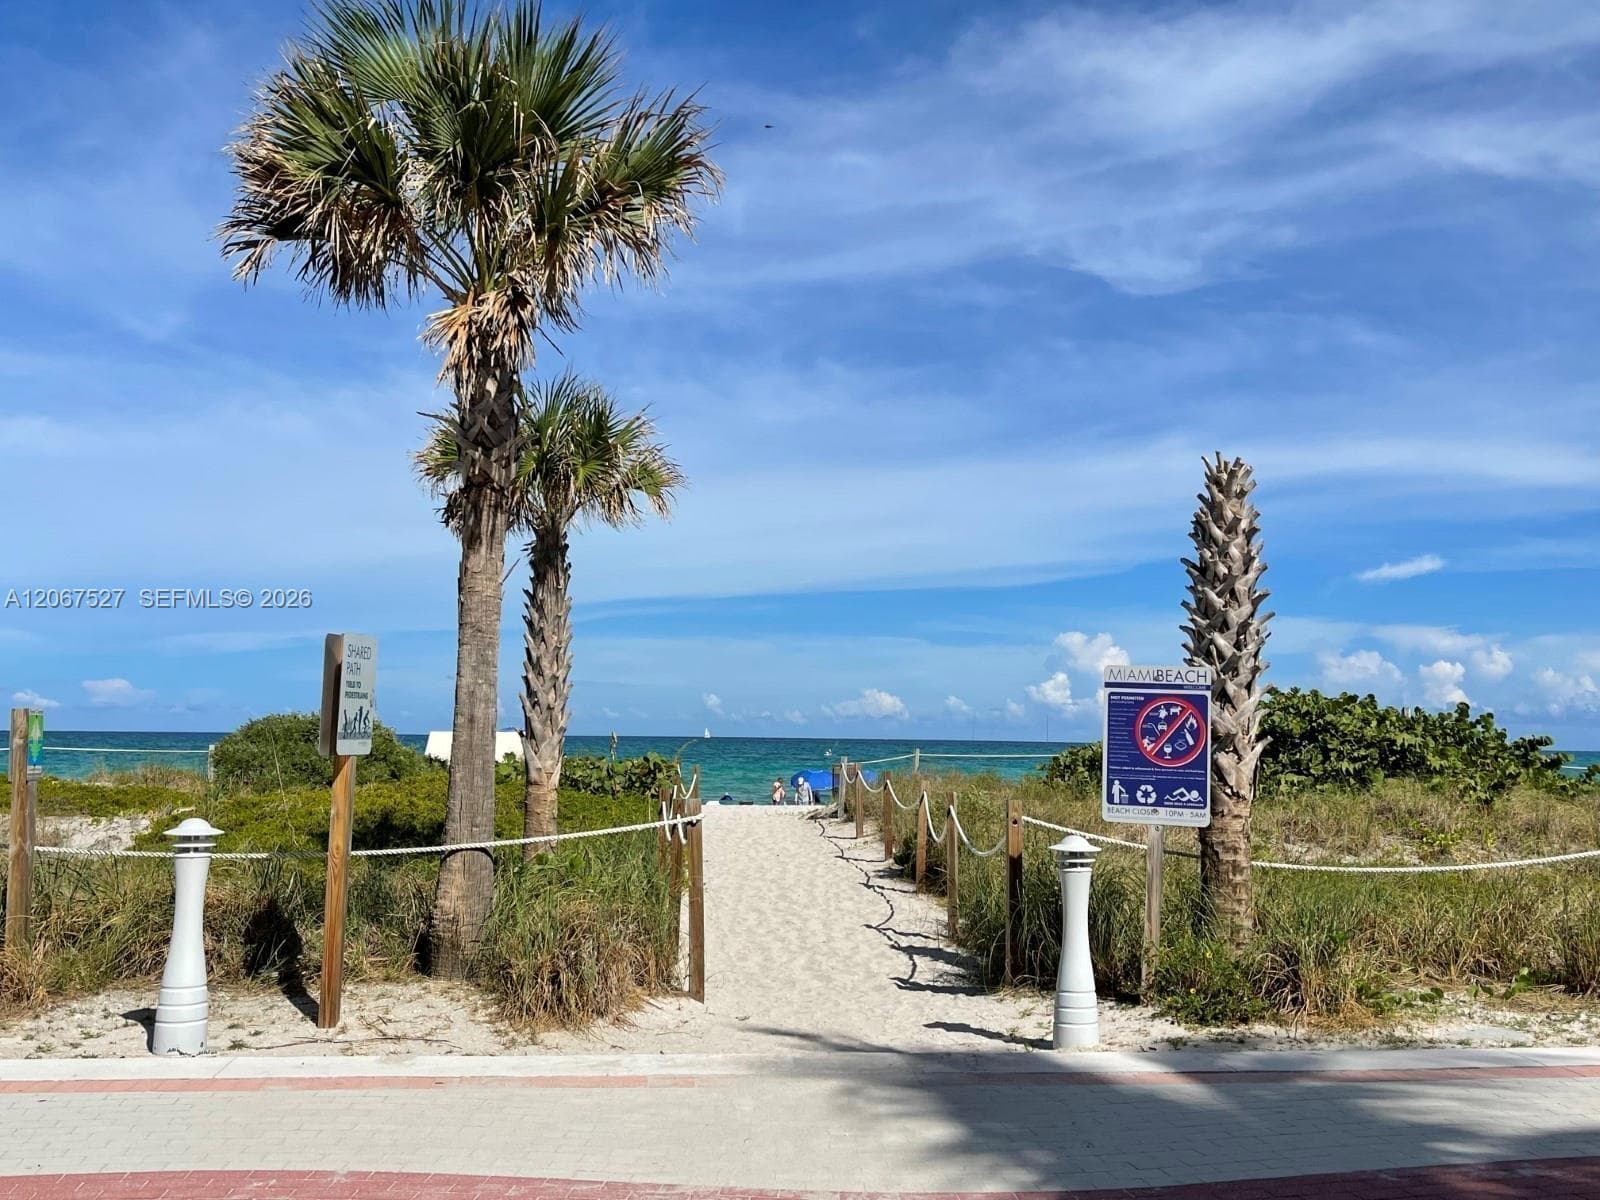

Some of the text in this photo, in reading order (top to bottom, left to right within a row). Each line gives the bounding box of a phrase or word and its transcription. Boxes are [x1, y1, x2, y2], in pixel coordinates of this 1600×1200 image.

[347, 643, 371, 660] SHARED
[346, 661, 361, 676] PATH
[1107, 806, 1130, 815] BEACH
[1165, 809, 1184, 817] 10PM
[1190, 810, 1206, 819] 5AM
